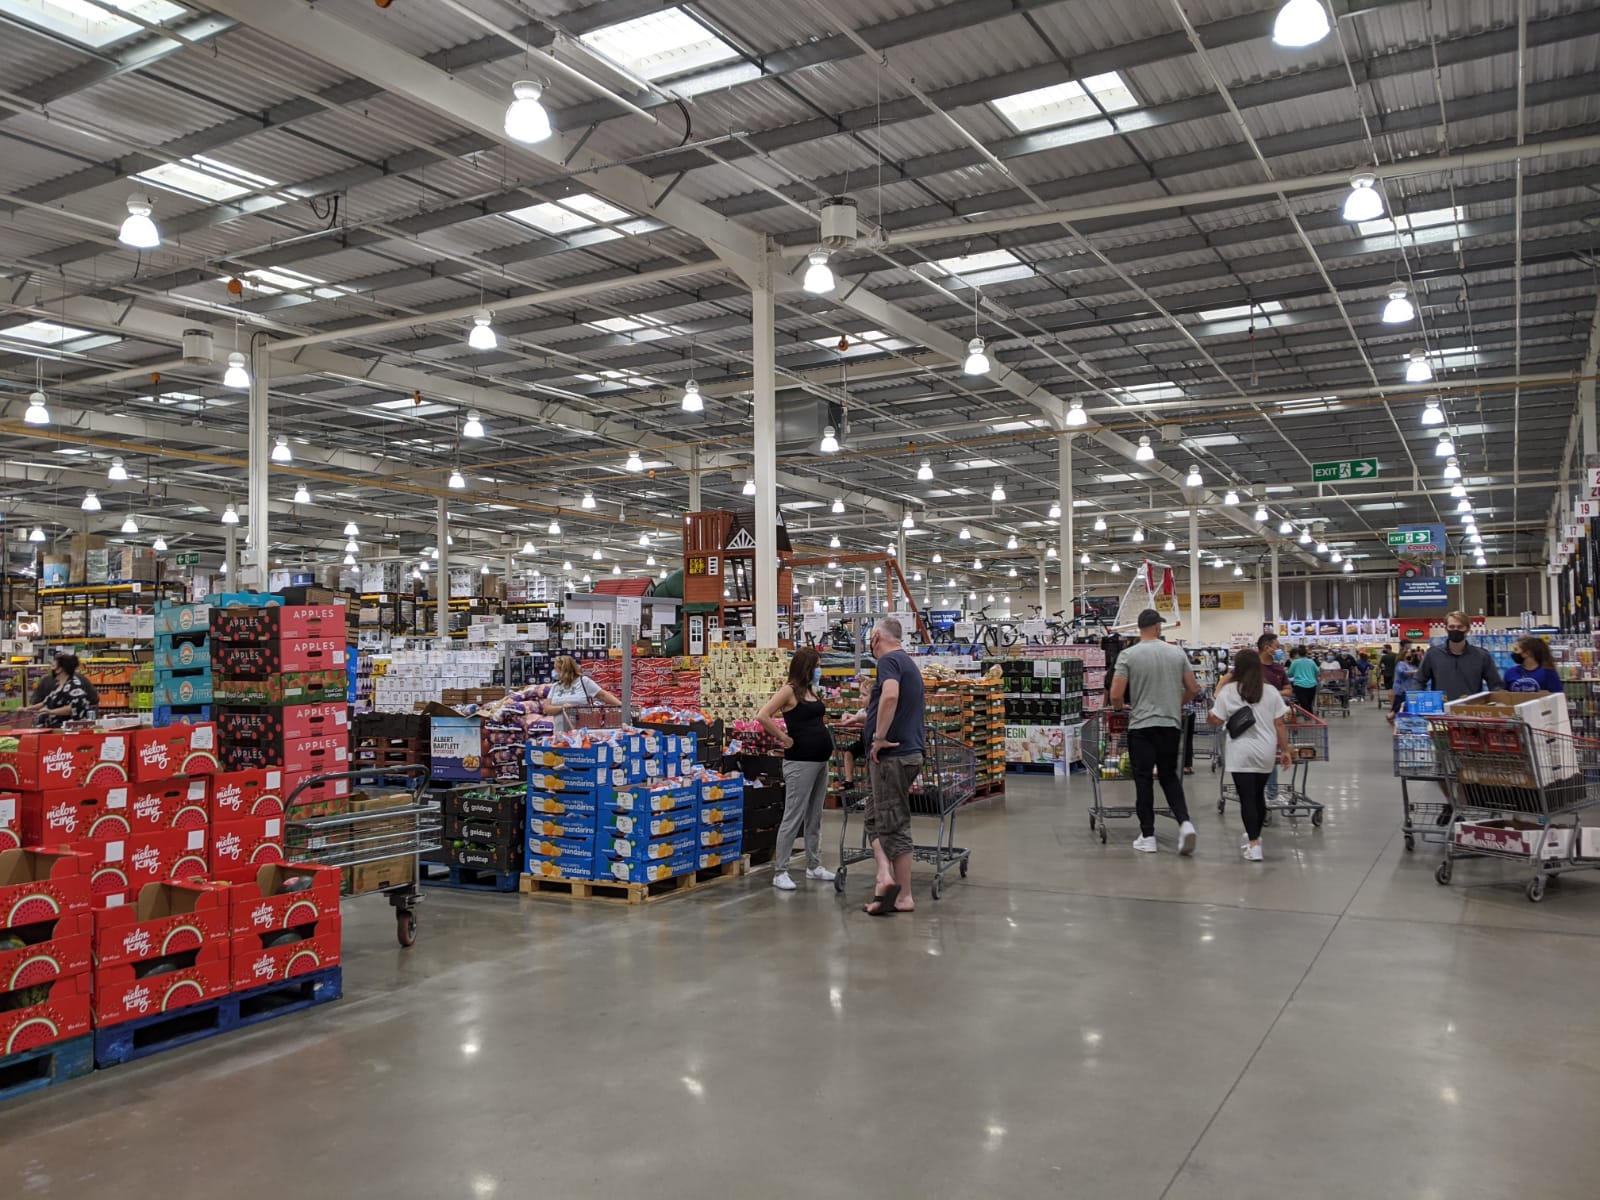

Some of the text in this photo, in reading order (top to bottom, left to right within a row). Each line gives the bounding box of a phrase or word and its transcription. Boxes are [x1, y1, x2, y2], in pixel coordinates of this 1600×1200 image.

[1315, 468, 1338, 477] EXIT
[1580, 504, 1590, 515] 19
[1570, 526, 1577, 536] 17
[1562, 544, 1568, 552] 15
[293, 609, 334, 619] APPLES
[230, 618, 259, 627] APPLES
[294, 642, 335, 651] APPLES
[230, 652, 260, 660] APPLES
[296, 706, 336, 718] APPLES
[232, 718, 262, 726] APPLES
[140, 740, 168, 757] melon
[297, 739, 338, 751] APPLES
[43, 746, 74, 764] melon
[232, 750, 263, 759] APPLES
[216, 784, 241, 799] melon
[134, 794, 161, 810] melon
[47, 802, 77, 820] melon
[471, 804, 493, 813] goldcup
[470, 829, 492, 838] goldcup
[216, 832, 240, 848] melon
[132, 844, 160, 862] melon
[562, 848, 592, 857] mandarins
[467, 855, 489, 863] goldcup
[562, 867, 591, 875] mandarins
[252, 902, 274, 920] melon
[123, 928, 151, 946] melon
[252, 954, 275, 971] melon
[123, 984, 150, 1002] melon
